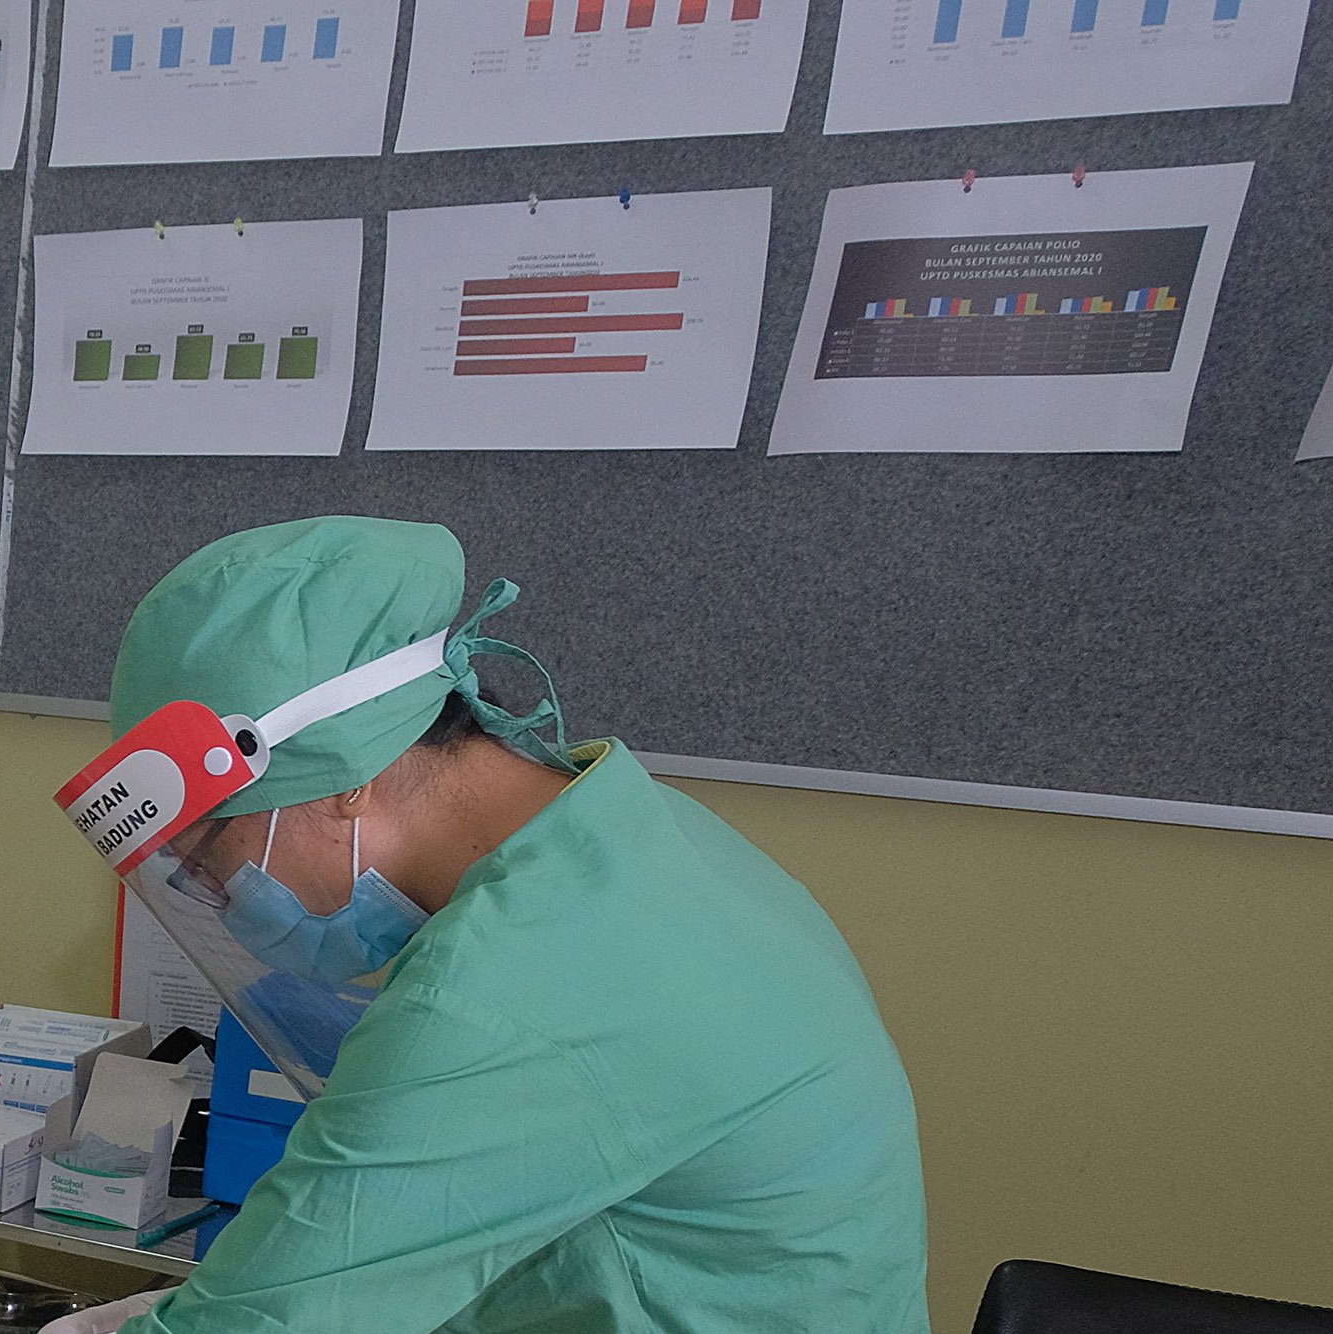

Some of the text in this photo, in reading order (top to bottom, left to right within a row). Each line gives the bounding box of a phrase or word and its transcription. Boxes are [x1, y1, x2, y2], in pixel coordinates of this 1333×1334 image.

[950, 239, 1082, 254] GRAFIK CAPAIAN POLIO
[925, 252, 1103, 268] BULAN SEPTEMBER TAHUN 2020
[920, 270, 951, 282] UPTD
[952, 268, 1020, 281] PUSKESMAS
[1020, 266, 1094, 280] ABIANSEMAL
[74, 781, 130, 834] EHATAN
[97, 798, 159, 858] BADUNG
[51, 1174, 84, 1190] Alcohol
